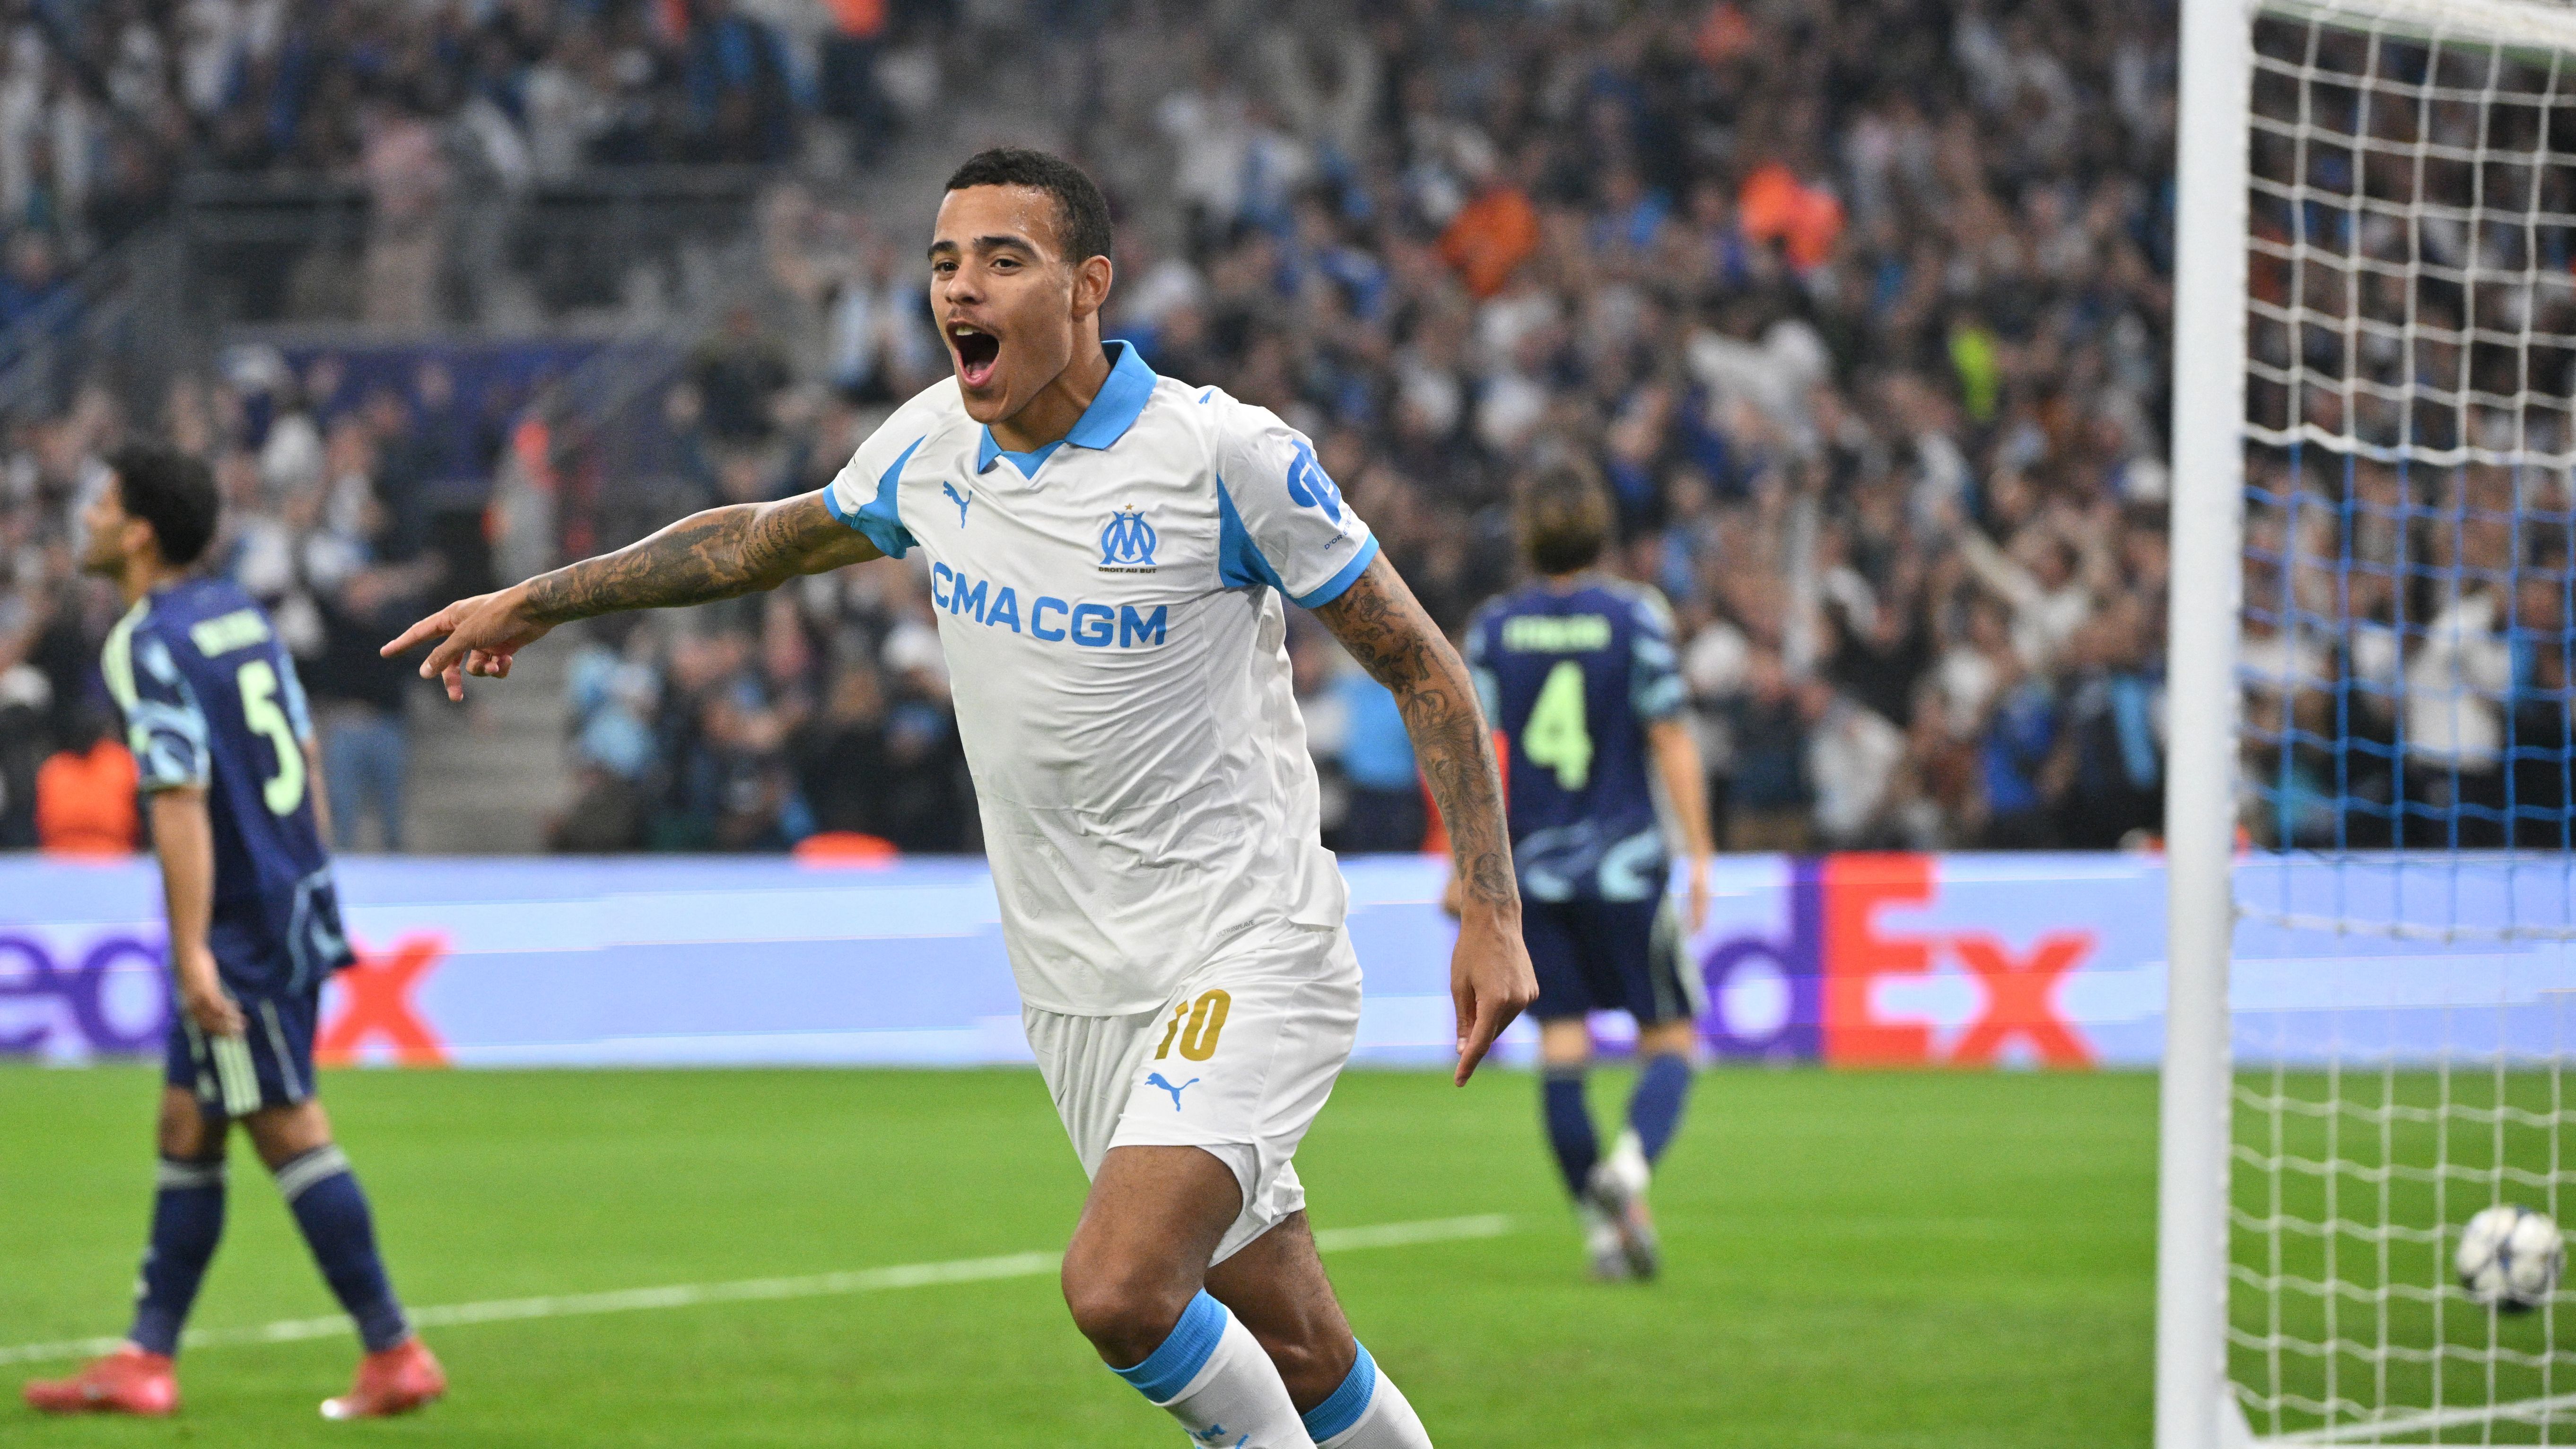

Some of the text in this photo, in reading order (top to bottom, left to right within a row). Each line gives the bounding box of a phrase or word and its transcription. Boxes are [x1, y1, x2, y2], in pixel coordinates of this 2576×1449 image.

[1325, 534, 1343, 550] D'OR
[933, 562, 1167, 647] CMA CGM
[238, 660, 305, 816] 5
[1520, 660, 1594, 791] 4
[1154, 988, 1231, 1061] 10
